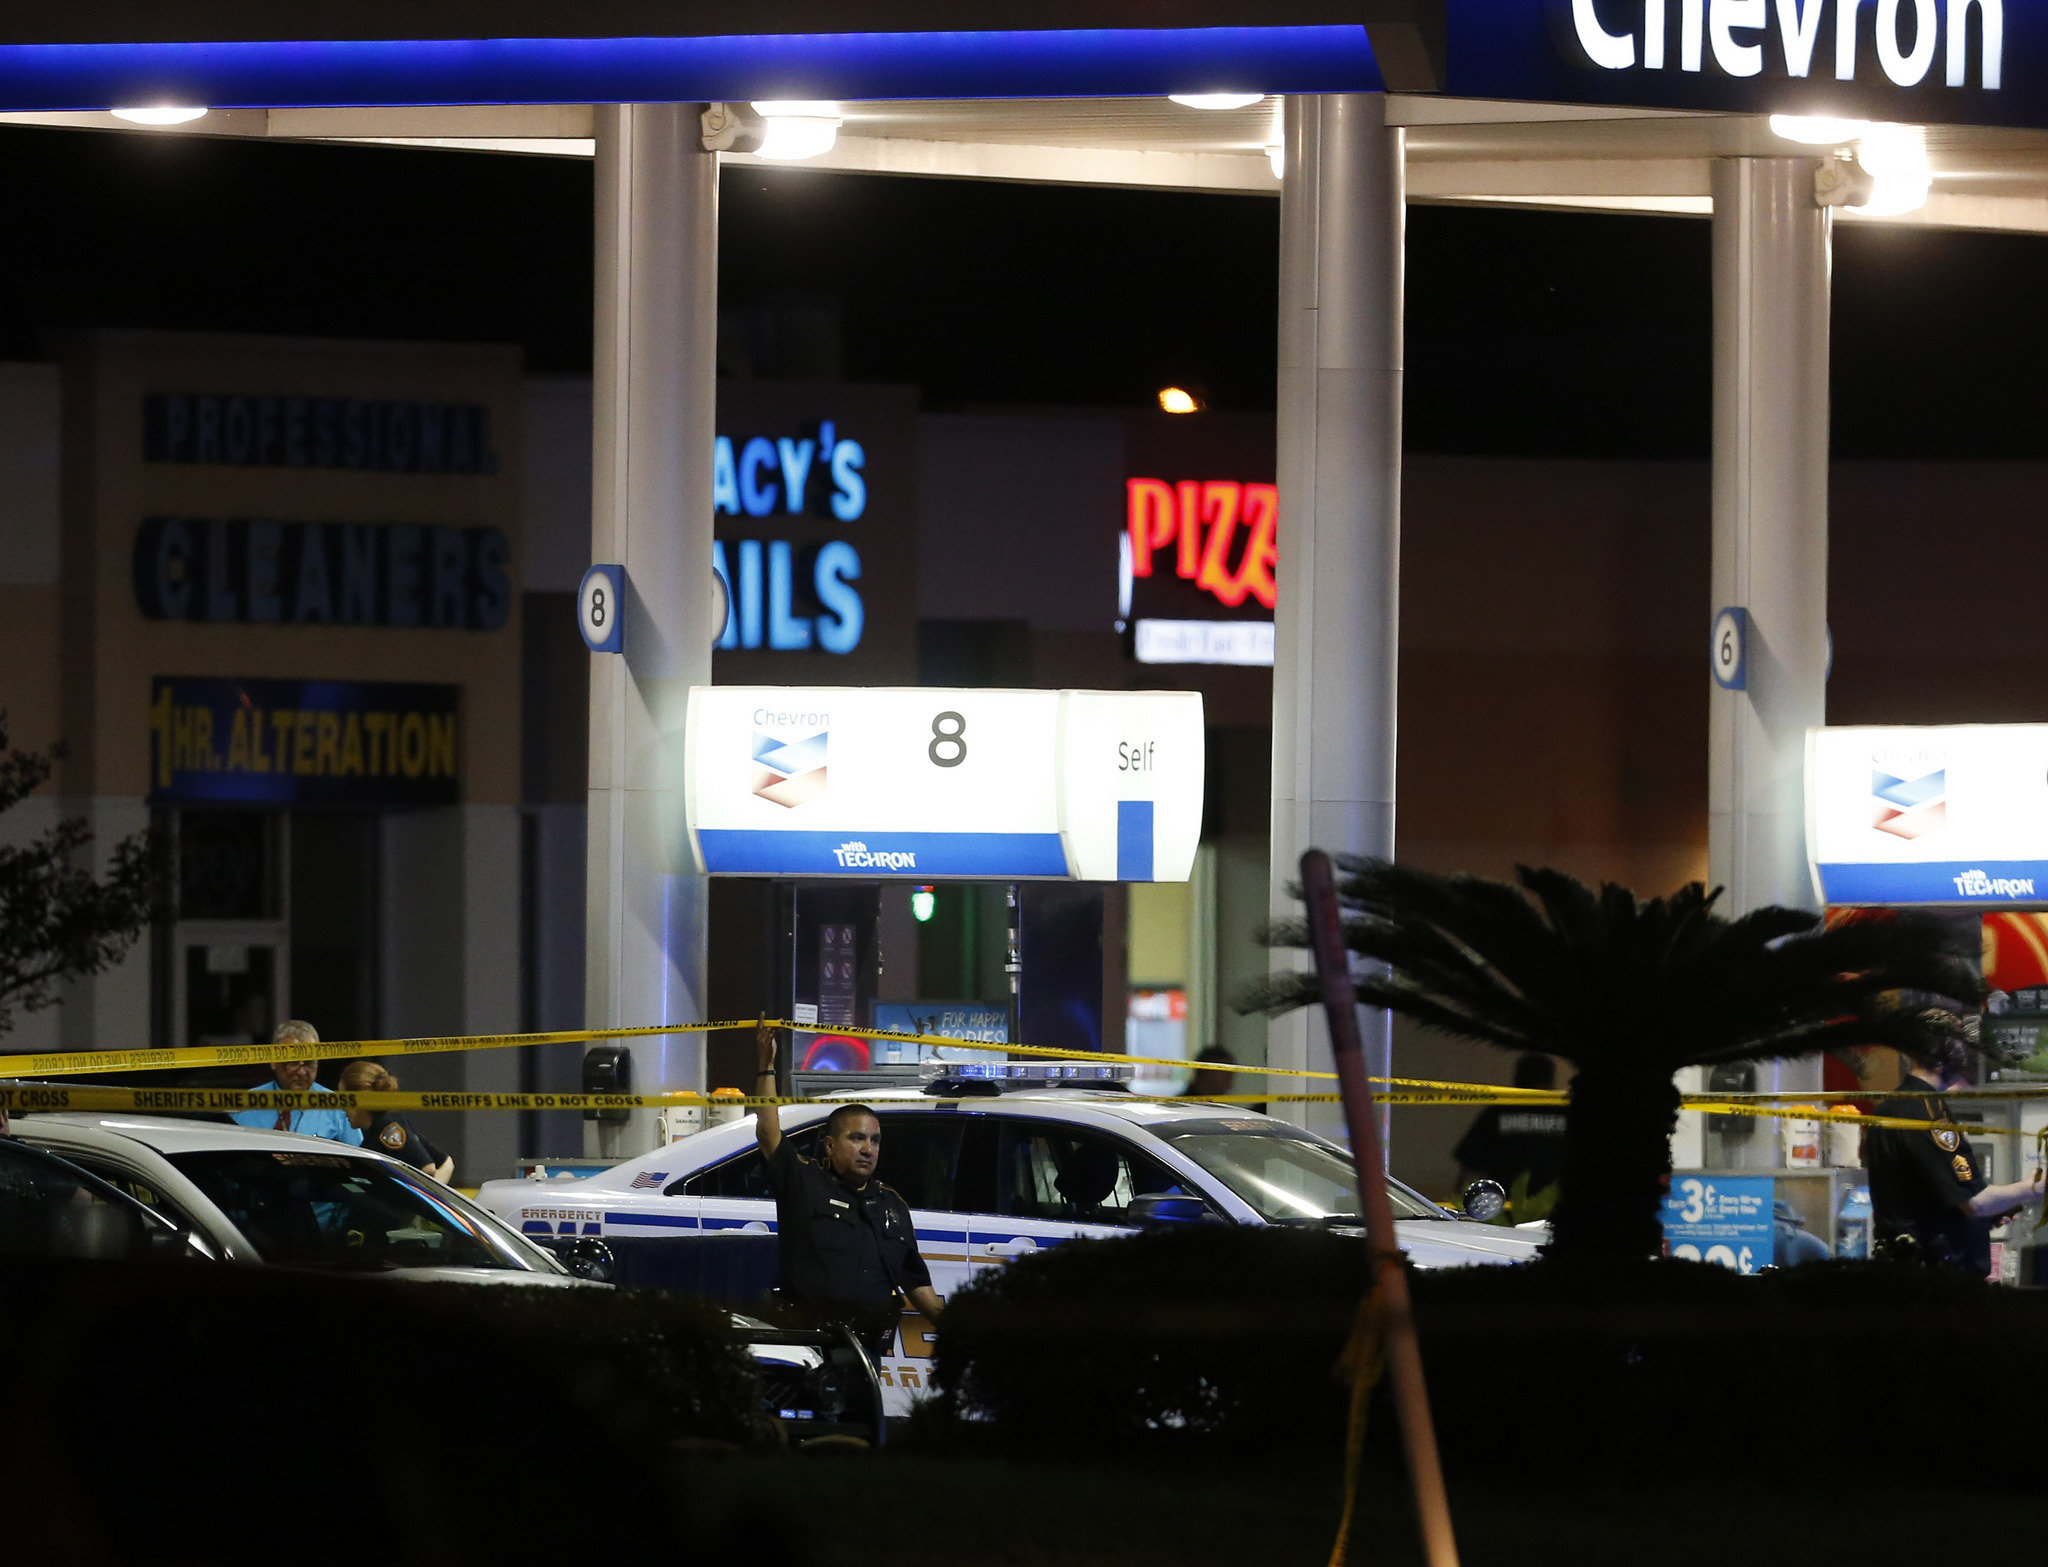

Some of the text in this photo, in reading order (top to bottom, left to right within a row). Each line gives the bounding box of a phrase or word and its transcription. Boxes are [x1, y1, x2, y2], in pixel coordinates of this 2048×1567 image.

[1572, 0, 2003, 90] Chevron
[164, 394, 498, 474] PROFESSIONAL
[155, 517, 512, 632] CLEANERS
[591, 588, 605, 627] 8
[1721, 629, 1733, 667] 6
[753, 708, 831, 726] Chevron
[175, 705, 223, 772] HR.
[226, 708, 458, 778] ALTERATION
[928, 710, 968, 768] 8
[1118, 740, 1155, 771] Self
[841, 841, 867, 852] with
[833, 847, 916, 871] TECHRON
[1953, 877, 2036, 900] TECHRON
[942, 1011, 1006, 1028] FOR HAPPY
[19, 1090, 70, 1107] CROSS
[133, 1090, 358, 1108] SHERIFFS LINE DO NOT CROSS
[421, 1094, 644, 1107] SHERIFFS LINE DO NOT CROSS
[521, 1208, 602, 1221] EMERGENCY
